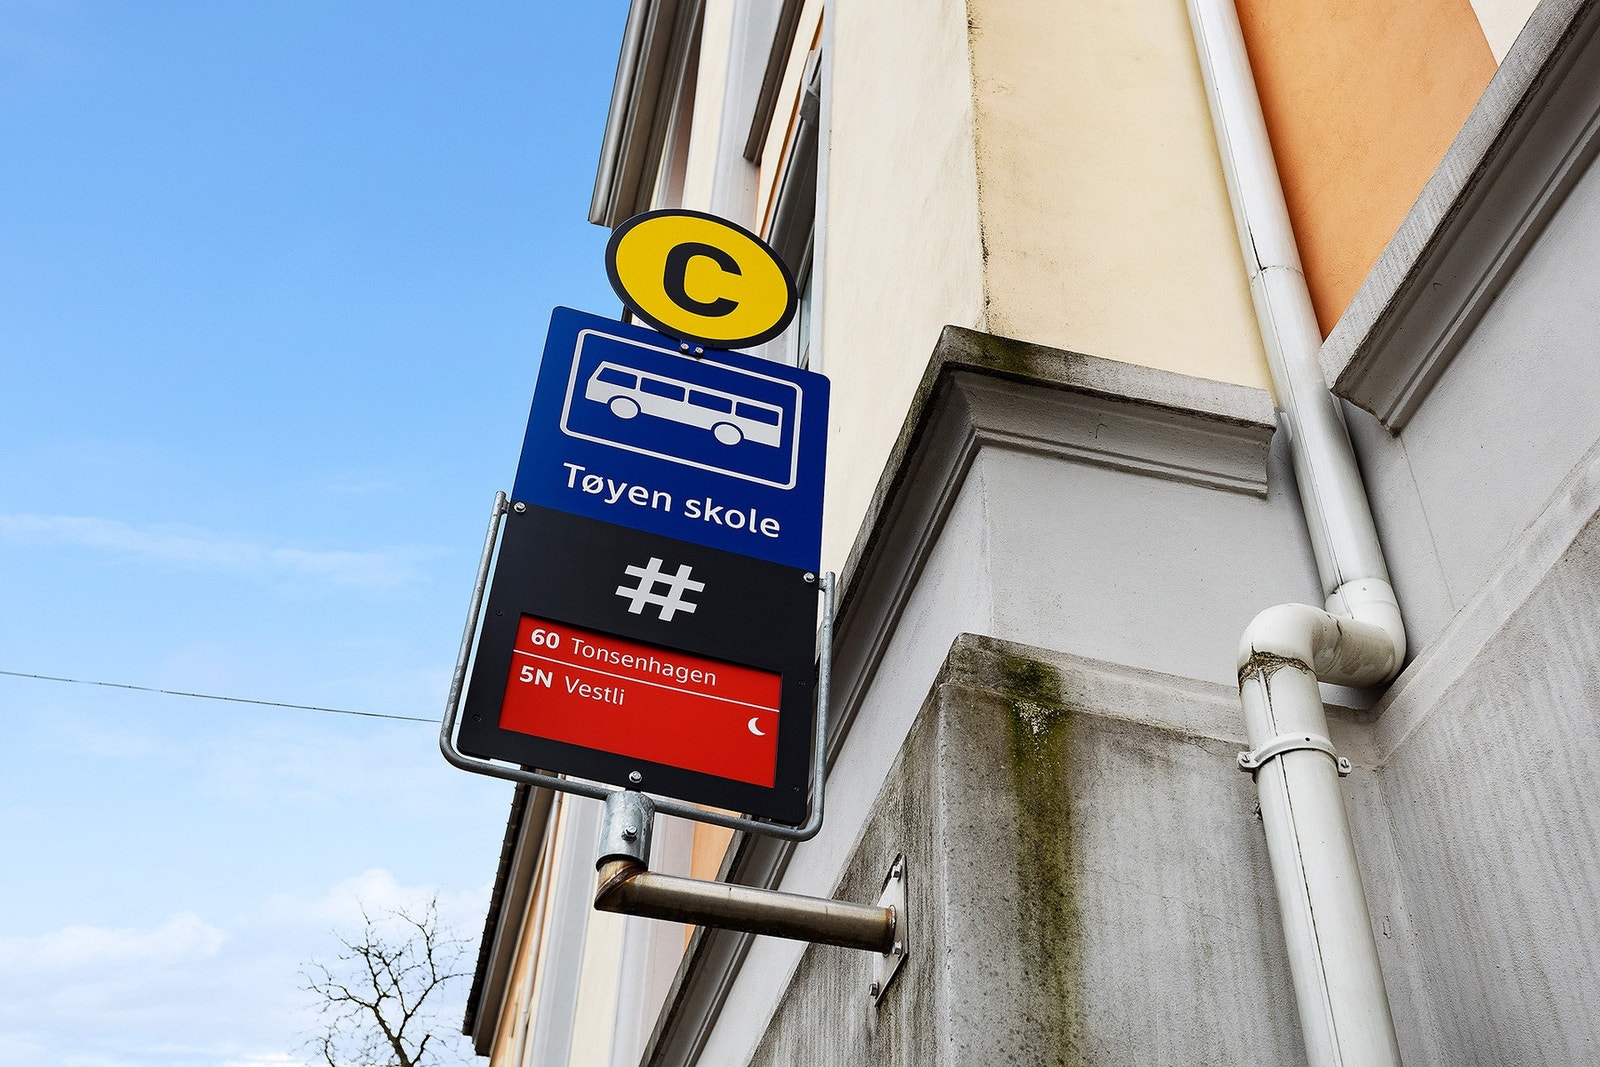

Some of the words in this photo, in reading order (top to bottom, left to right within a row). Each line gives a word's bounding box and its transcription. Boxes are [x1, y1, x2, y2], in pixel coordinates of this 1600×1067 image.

[663, 241, 743, 318] C
[563, 462, 672, 513] Tøyen
[684, 496, 781, 539] skole
[519, 665, 554, 689] 5N
[564, 675, 625, 706] Vestli
[530, 628, 560, 650] 60
[571, 637, 717, 687] Tonsenhagen
